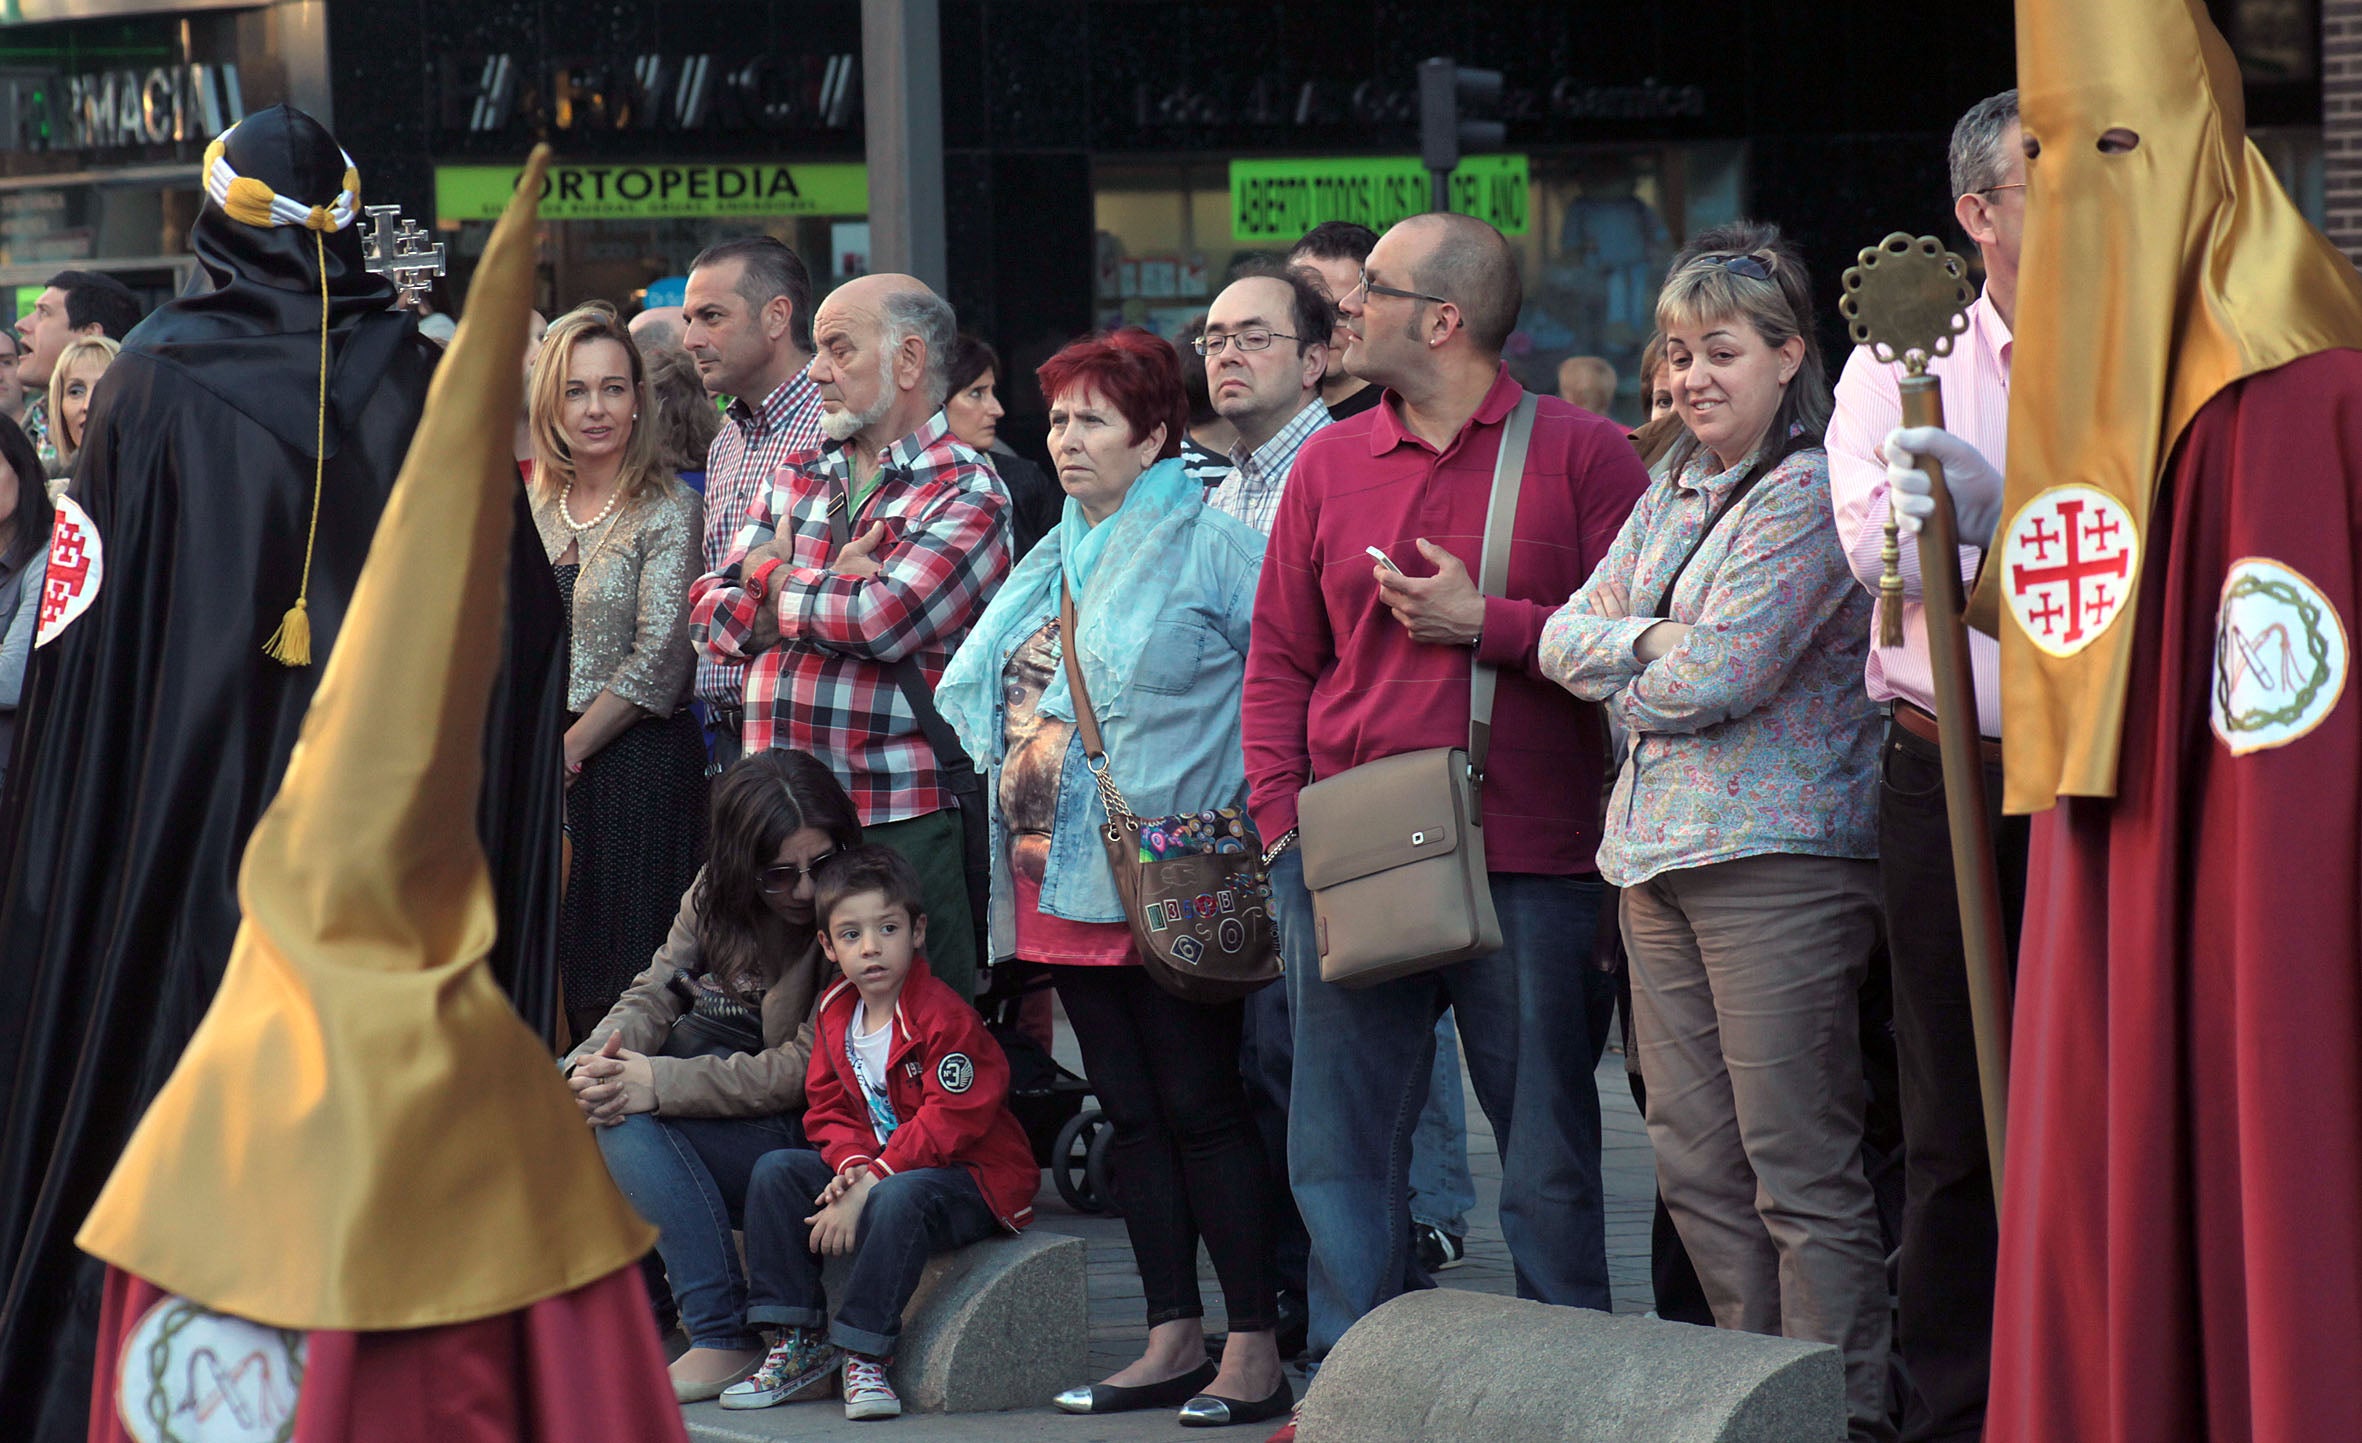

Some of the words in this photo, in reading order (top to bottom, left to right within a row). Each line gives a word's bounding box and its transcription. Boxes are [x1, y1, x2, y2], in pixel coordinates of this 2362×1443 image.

[513, 168, 799, 201] ORTOPEDIA
[1240, 176, 1309, 232] ABIERTO
[1314, 175, 1369, 228] TODOS
[1374, 174, 1408, 229] LOS
[1221, 893, 1231, 908] B
[946, 1062, 960, 1087] 3
